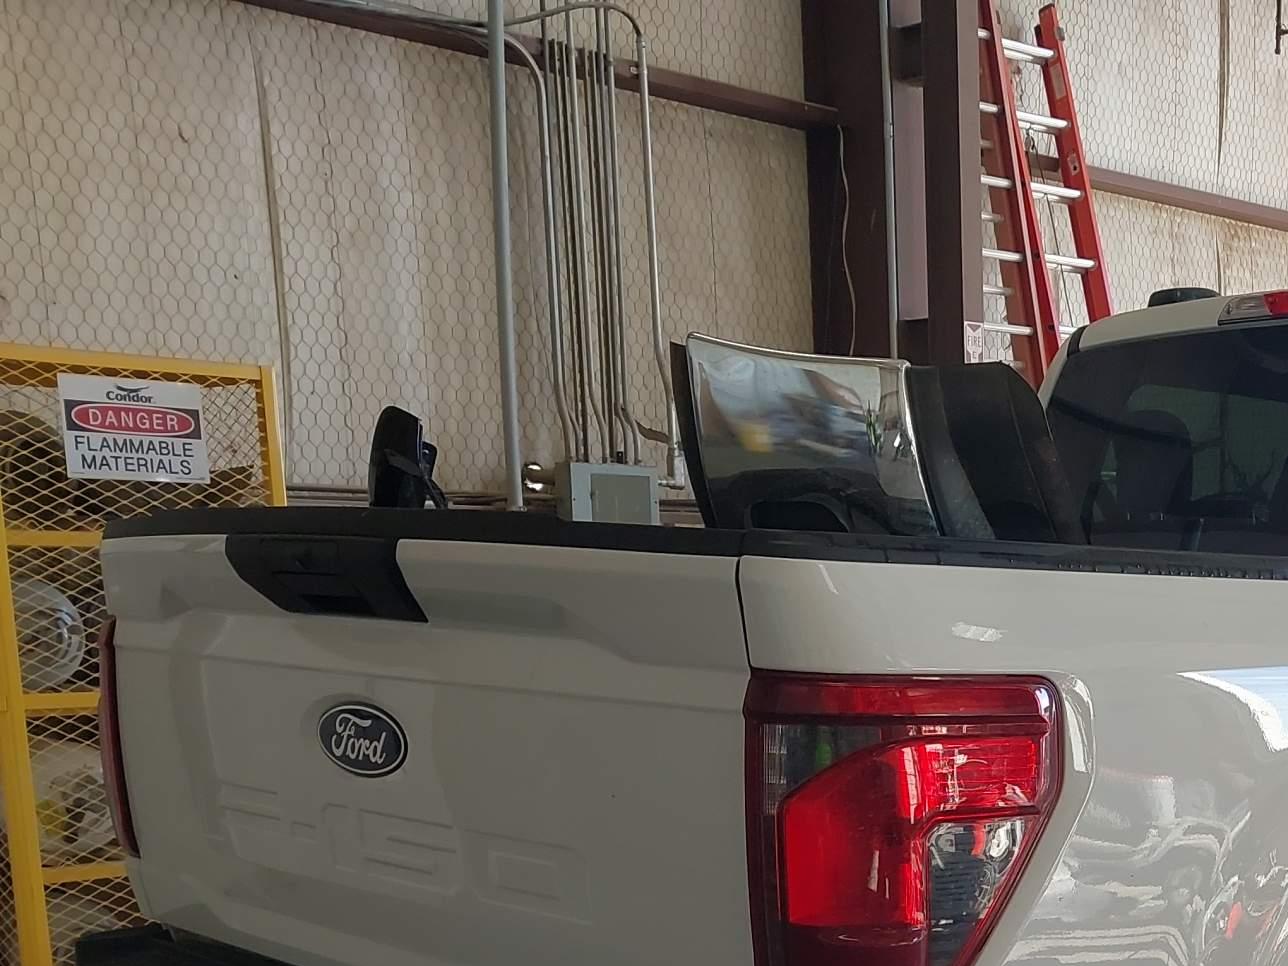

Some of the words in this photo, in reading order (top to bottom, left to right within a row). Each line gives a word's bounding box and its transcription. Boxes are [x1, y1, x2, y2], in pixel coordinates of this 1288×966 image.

[967, 335, 982, 348] FIRE
[105, 390, 154, 404] Condor
[88, 408, 179, 431] DANGER
[74, 435, 195, 458] FLAMMABLE
[81, 454, 192, 476] MATERIALS
[331, 713, 387, 764] Ford
